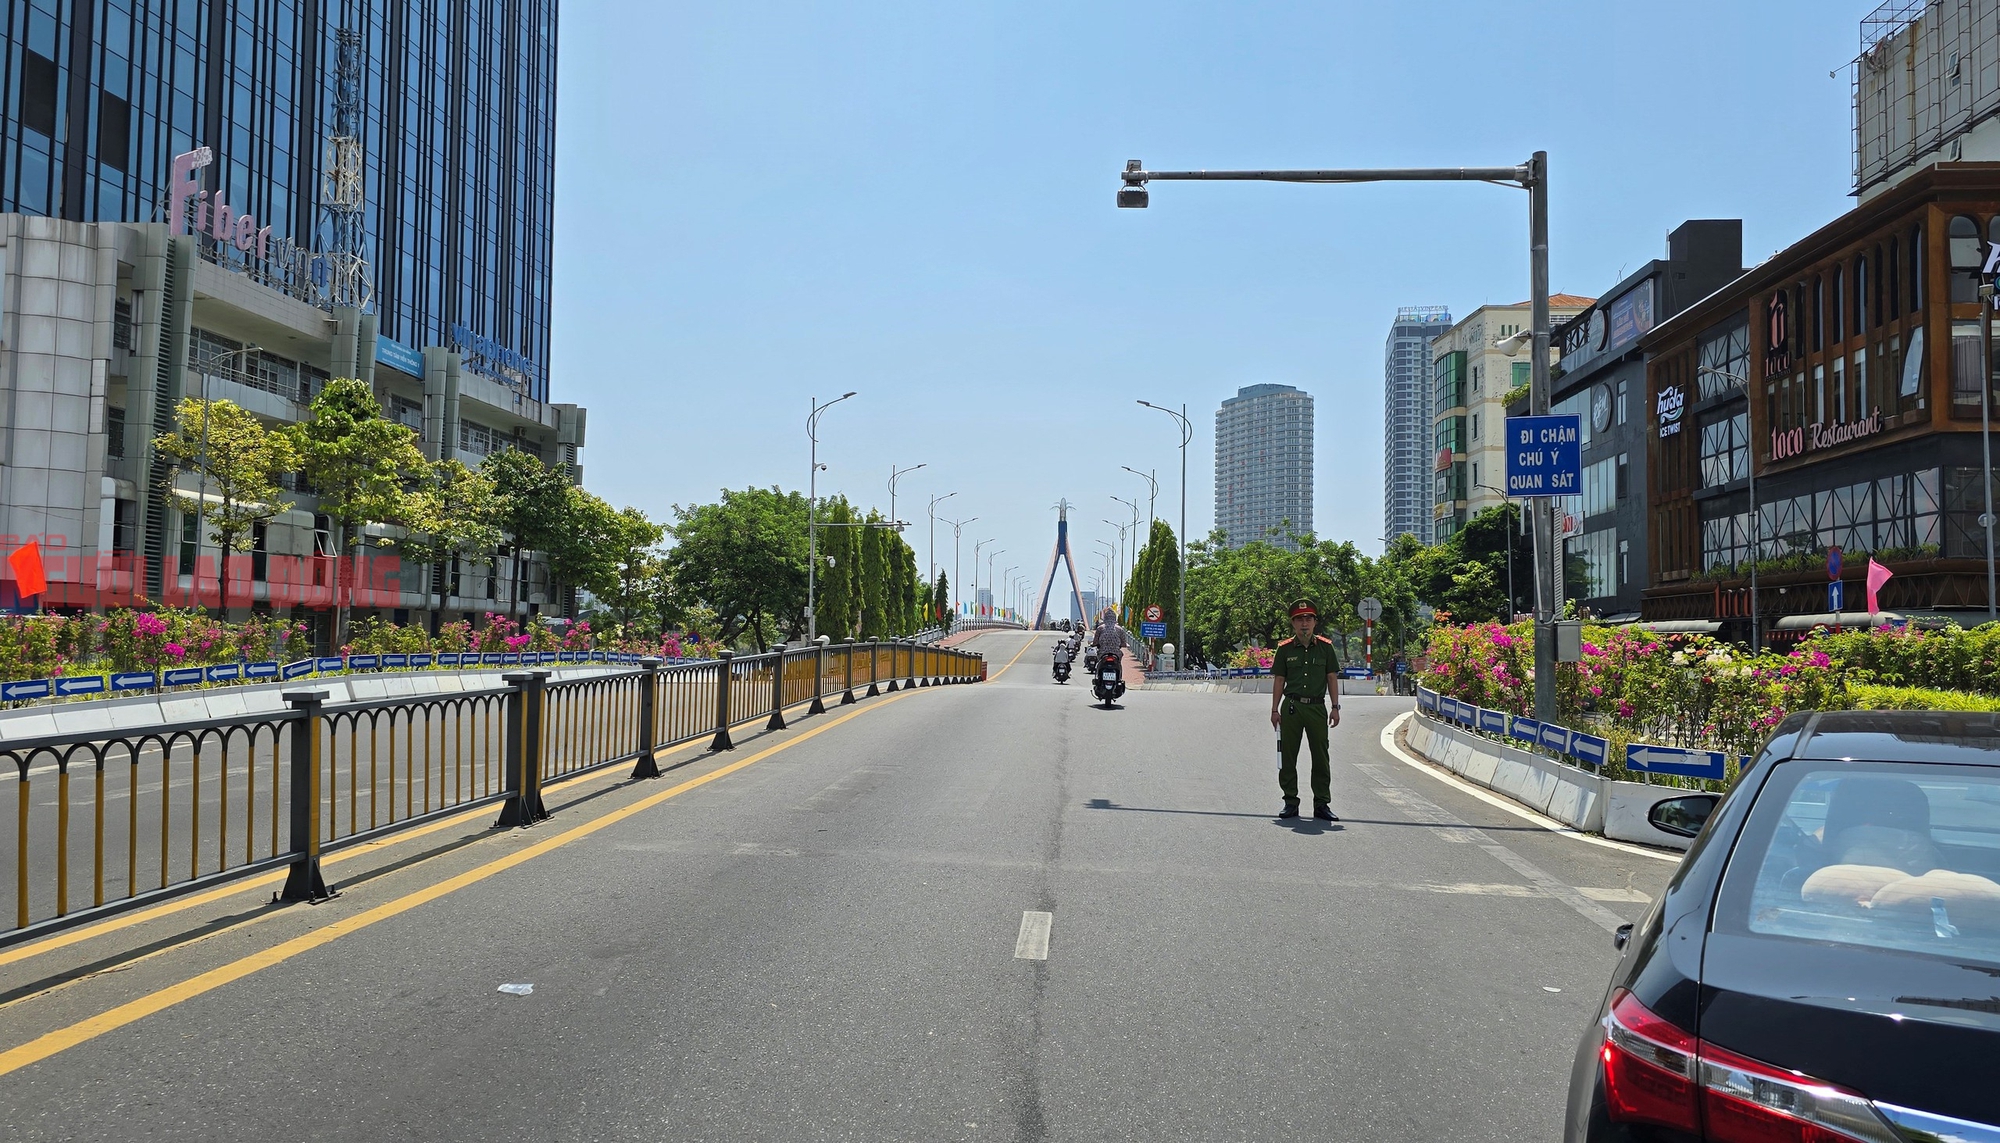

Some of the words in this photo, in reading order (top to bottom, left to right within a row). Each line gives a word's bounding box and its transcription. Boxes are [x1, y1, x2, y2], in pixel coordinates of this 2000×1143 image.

[171, 146, 272, 260] Fiber
[452, 320, 532, 378] vinaphone
[1656, 385, 1684, 415] huda
[1520, 429, 1533, 444] ĐI
[1540, 425, 1576, 445] CHẬM
[1810, 405, 1883, 449] Restaurant
[1519, 448, 1543, 466] CHÚ
[1550, 447, 1559, 466] Ý
[1510, 474, 1543, 490] QUAN
[1551, 469, 1574, 488] SÁT
